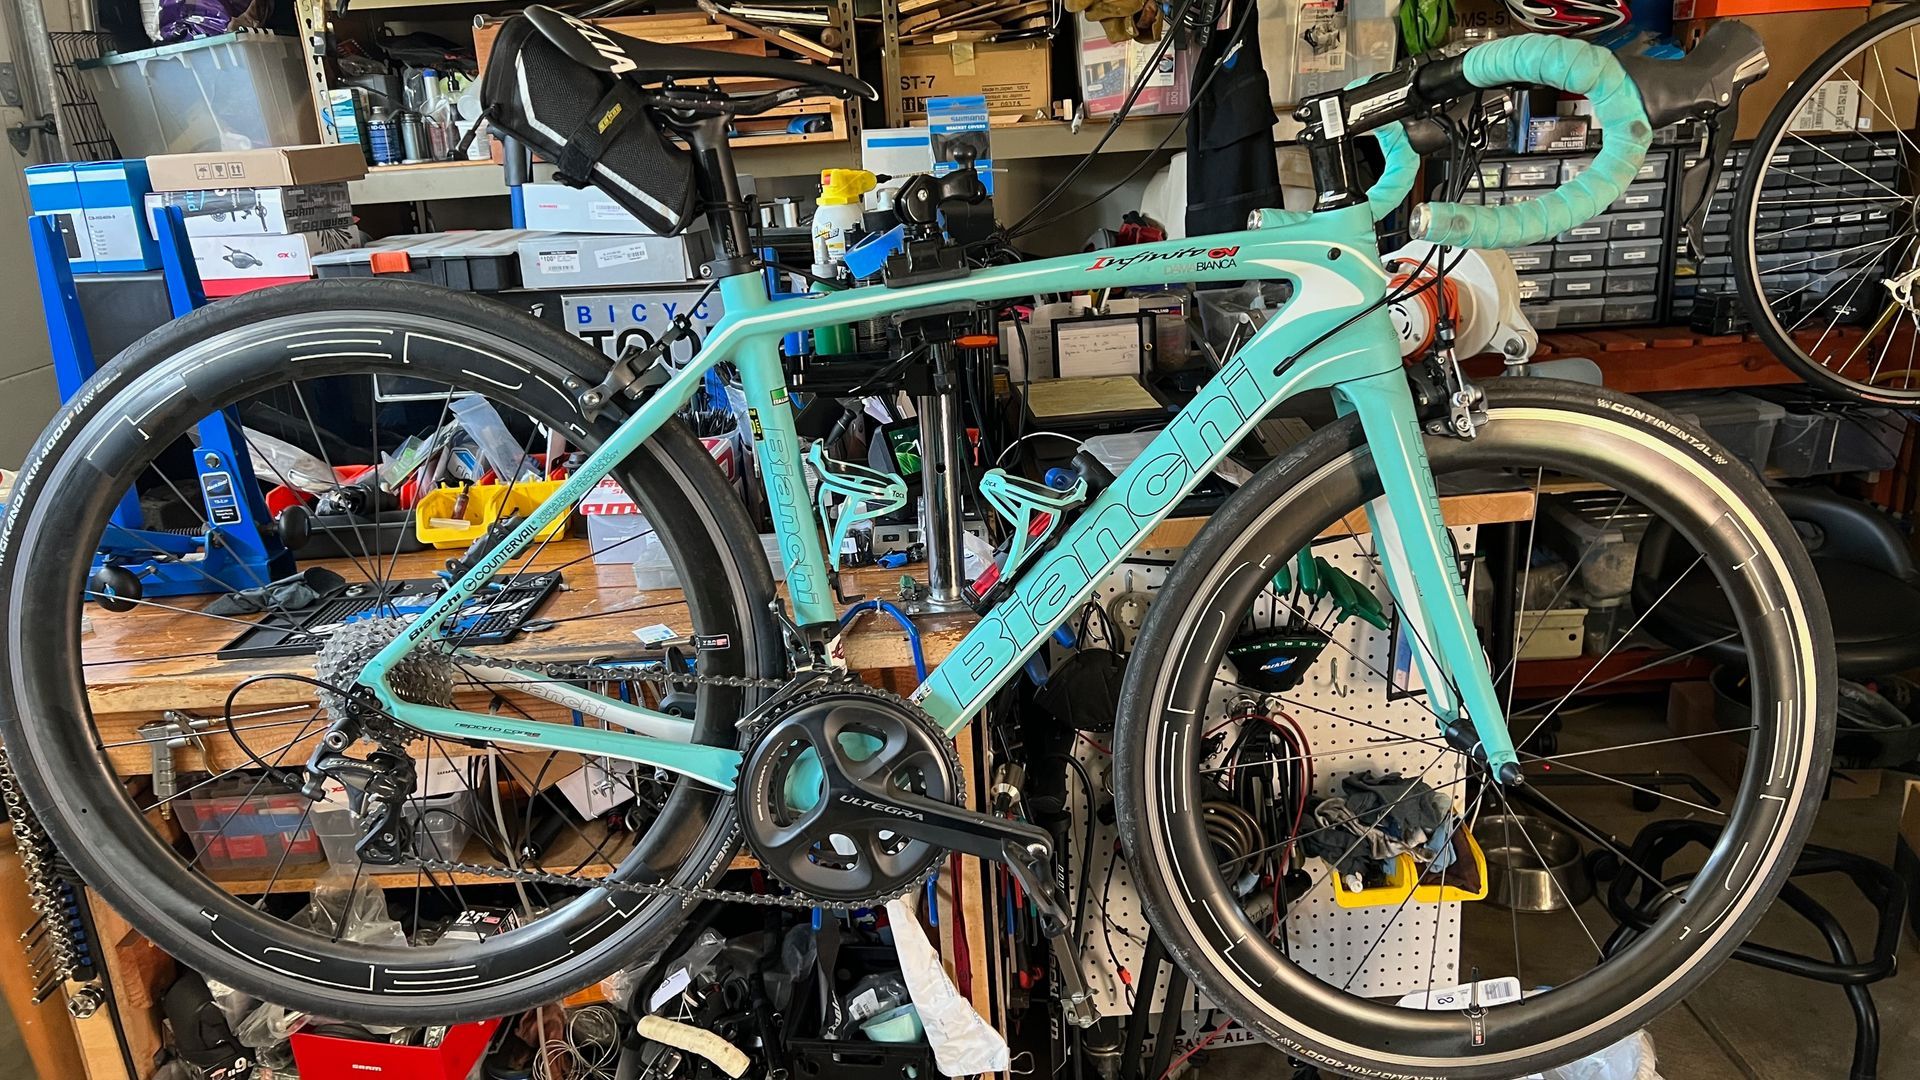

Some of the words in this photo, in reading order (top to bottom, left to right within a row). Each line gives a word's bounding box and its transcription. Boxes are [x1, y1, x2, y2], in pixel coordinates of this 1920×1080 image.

[950, 115, 986, 123] SHIMANO
[285, 208, 315, 217] SRAM
[1085, 246, 1206, 271] Infinito
[576, 302, 709, 324] BICYC
[1611, 402, 1713, 457] CONTINENTAL
[577, 449, 620, 490] TECHNOLOGY
[0, 494, 24, 552] GRAND
[20, 457, 43, 496] PRIX
[763, 427, 820, 605] Bianchi
[941, 358, 1267, 708] Bianchi
[408, 591, 462, 642] Bianchi
[502, 672, 608, 718] Bianchi
[839, 794, 924, 822] ULTEGRA
[1224, 1032, 1254, 1044] ALE
[351, 1064, 382, 1072] SRAM
